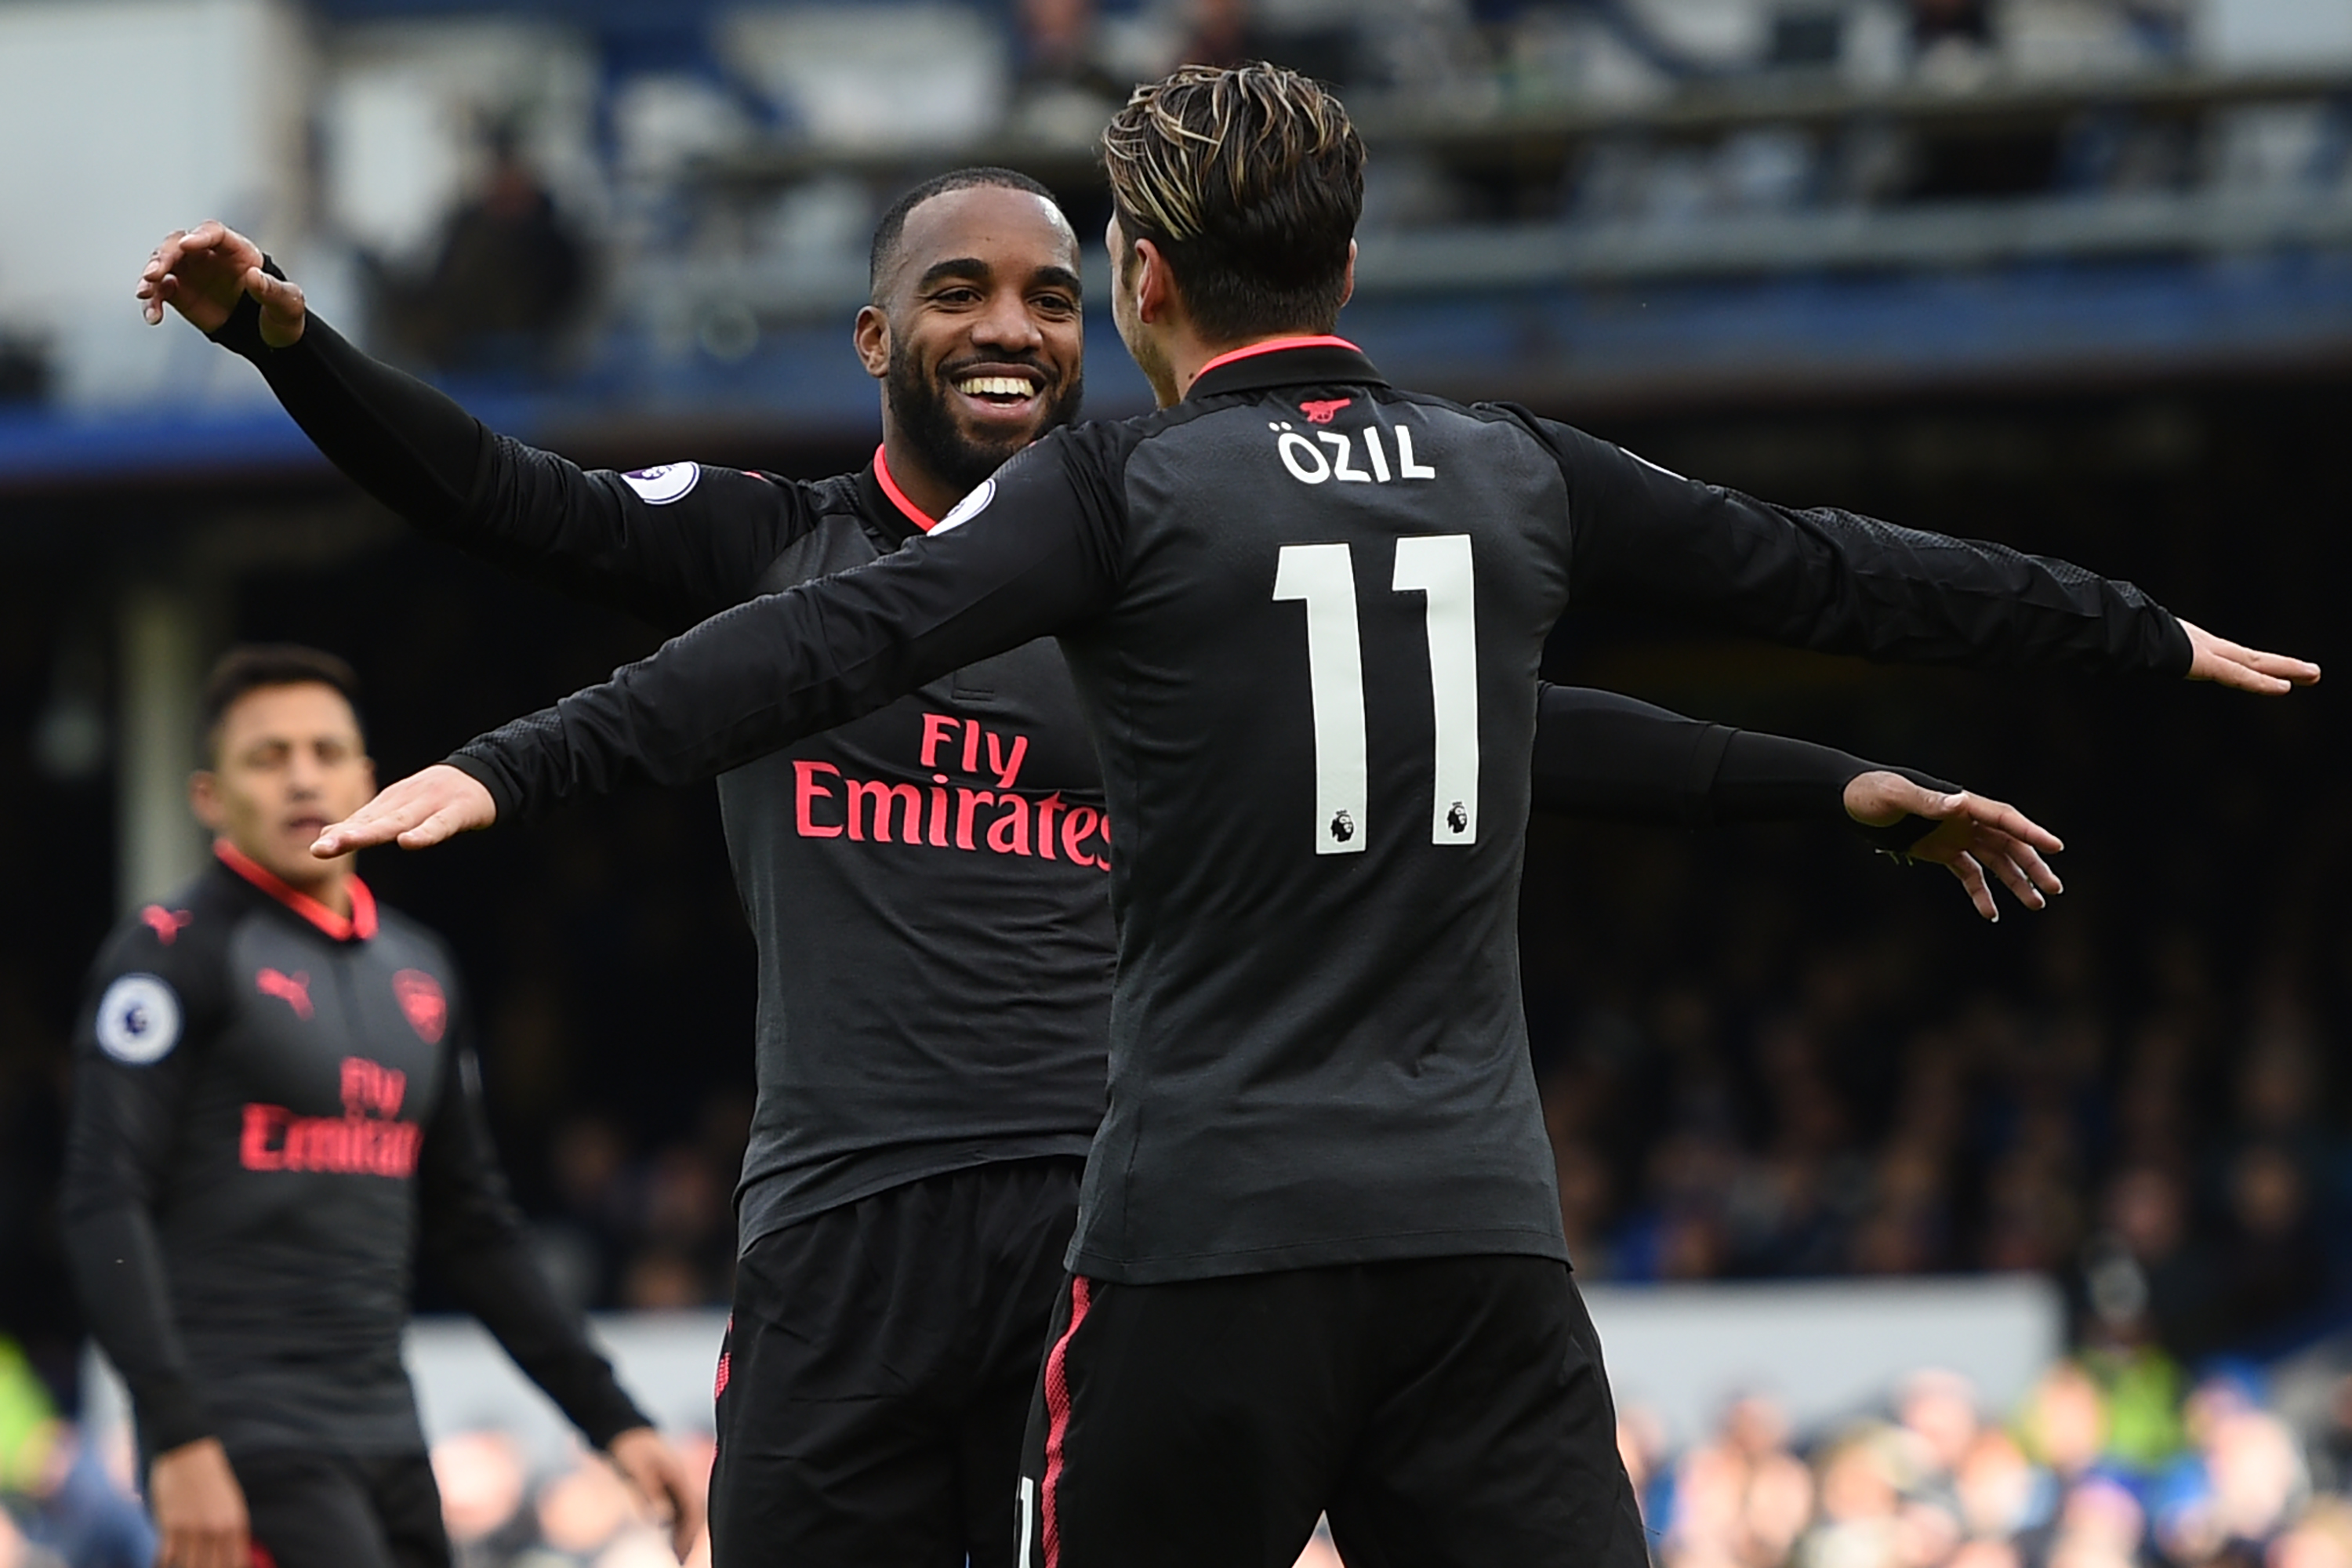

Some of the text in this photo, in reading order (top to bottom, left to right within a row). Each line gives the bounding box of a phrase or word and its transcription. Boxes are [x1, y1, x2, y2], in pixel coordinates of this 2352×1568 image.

[1269, 421, 1436, 485] ÖZIL
[1272, 534, 1479, 855] 11
[920, 713, 1029, 789] Fly
